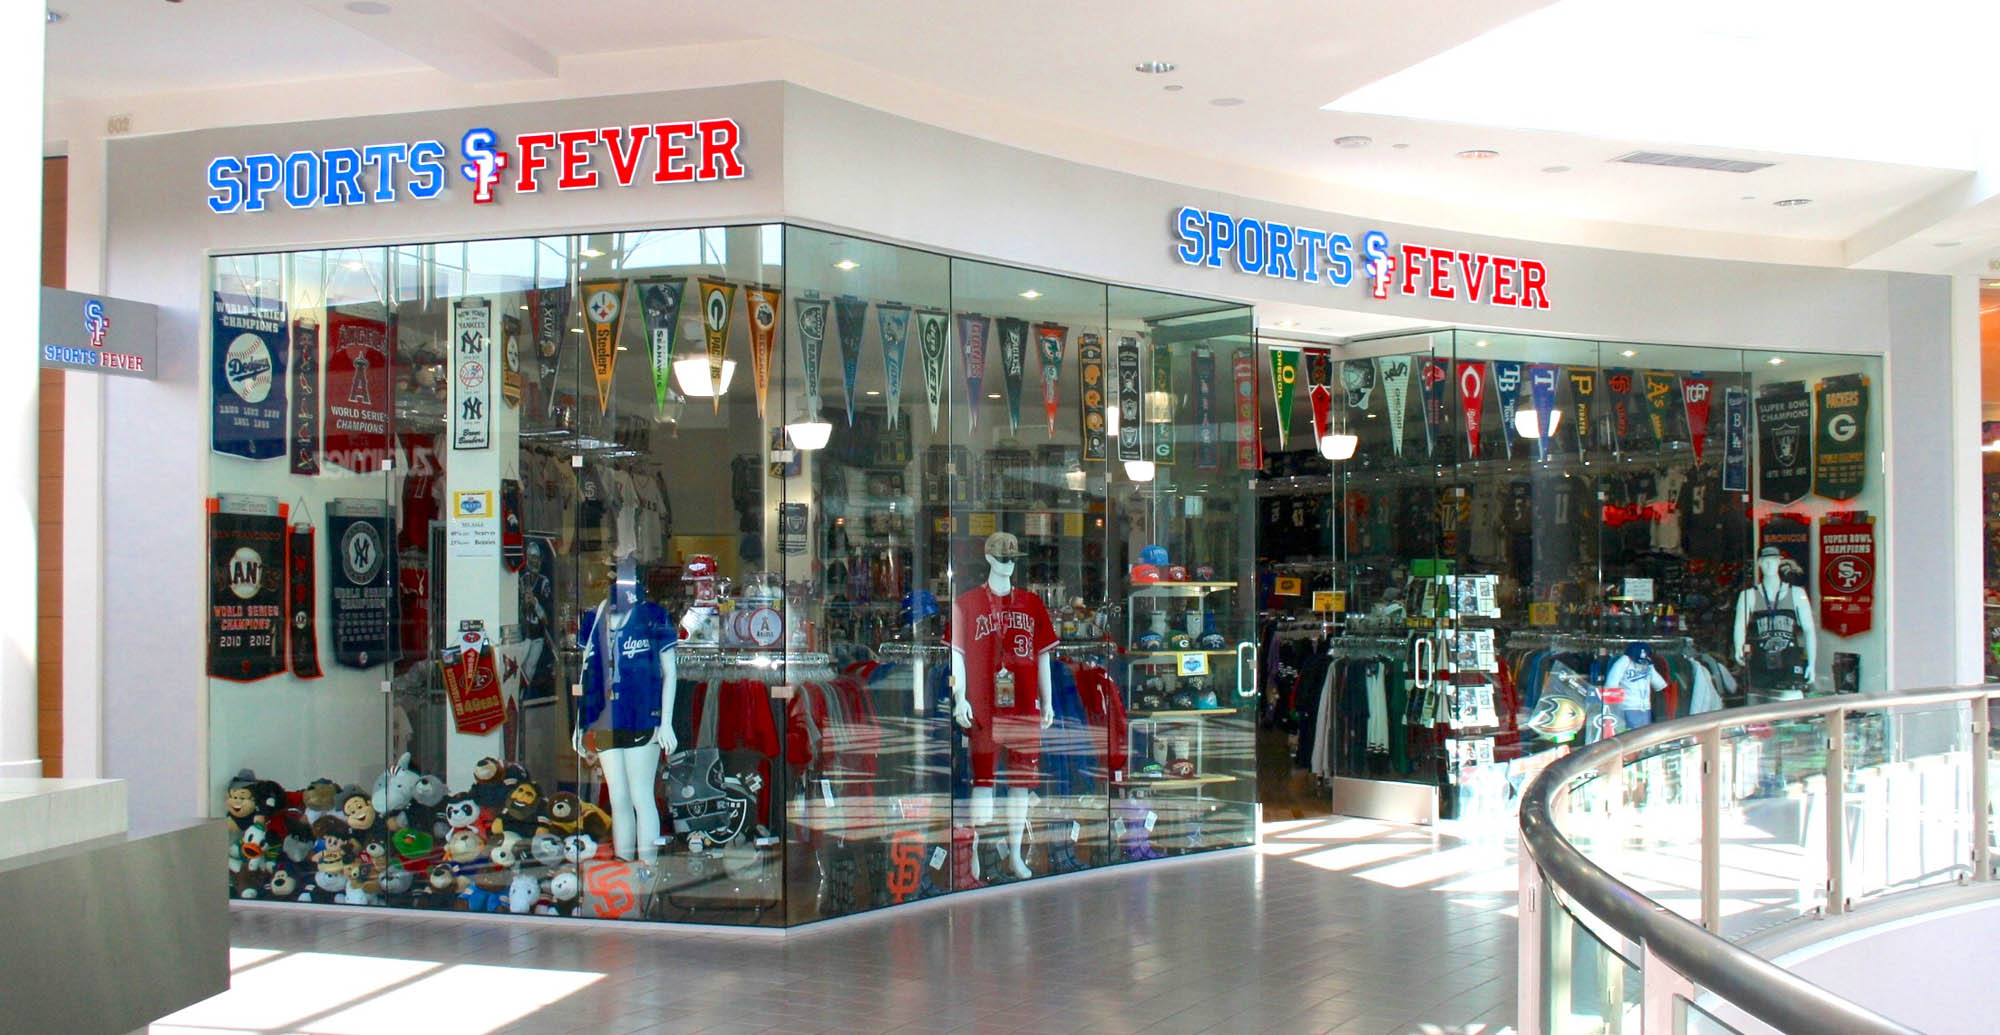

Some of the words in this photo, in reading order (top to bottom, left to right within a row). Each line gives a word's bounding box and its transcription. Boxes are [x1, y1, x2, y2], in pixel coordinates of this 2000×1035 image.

[207, 139, 445, 214] SPORTS
[515, 117, 745, 193] FEVER
[1178, 206, 1354, 288] SPORTS
[1400, 242, 1551, 311] FEVER
[222, 315, 280, 333] CHAMPIONS
[461, 330, 483, 354] NY
[597, 328, 611, 376] Steelers
[1006, 327, 1021, 377] EAGLES
[44, 343, 97, 366] SPORTS
[100, 351, 144, 372] FEVER
[808, 343, 817, 397] RAIDERS
[928, 360, 938, 407] JETS
[1571, 375, 1593, 395] P
[331, 405, 360, 419] WORLD
[462, 396, 483, 421] NY
[1760, 409, 1809, 422] CHAMPIONS
[336, 418, 385, 435] CHAMPIONS
[1828, 413, 1857, 442] G
[1823, 535, 1848, 544] SUPER
[1849, 534, 1872, 543] BOWL
[1825, 544, 1871, 554] CHAMPIONS
[353, 537, 370, 569] NY
[1838, 561, 1862, 588] SF
[213, 605, 243, 618] WORLD
[247, 605, 279, 618] SERIES
[220, 618, 271, 631] CHAMPIONS
[975, 611, 1035, 641] ANGELS
[220, 635, 242, 648] 2010
[249, 635, 272, 647] 2012
